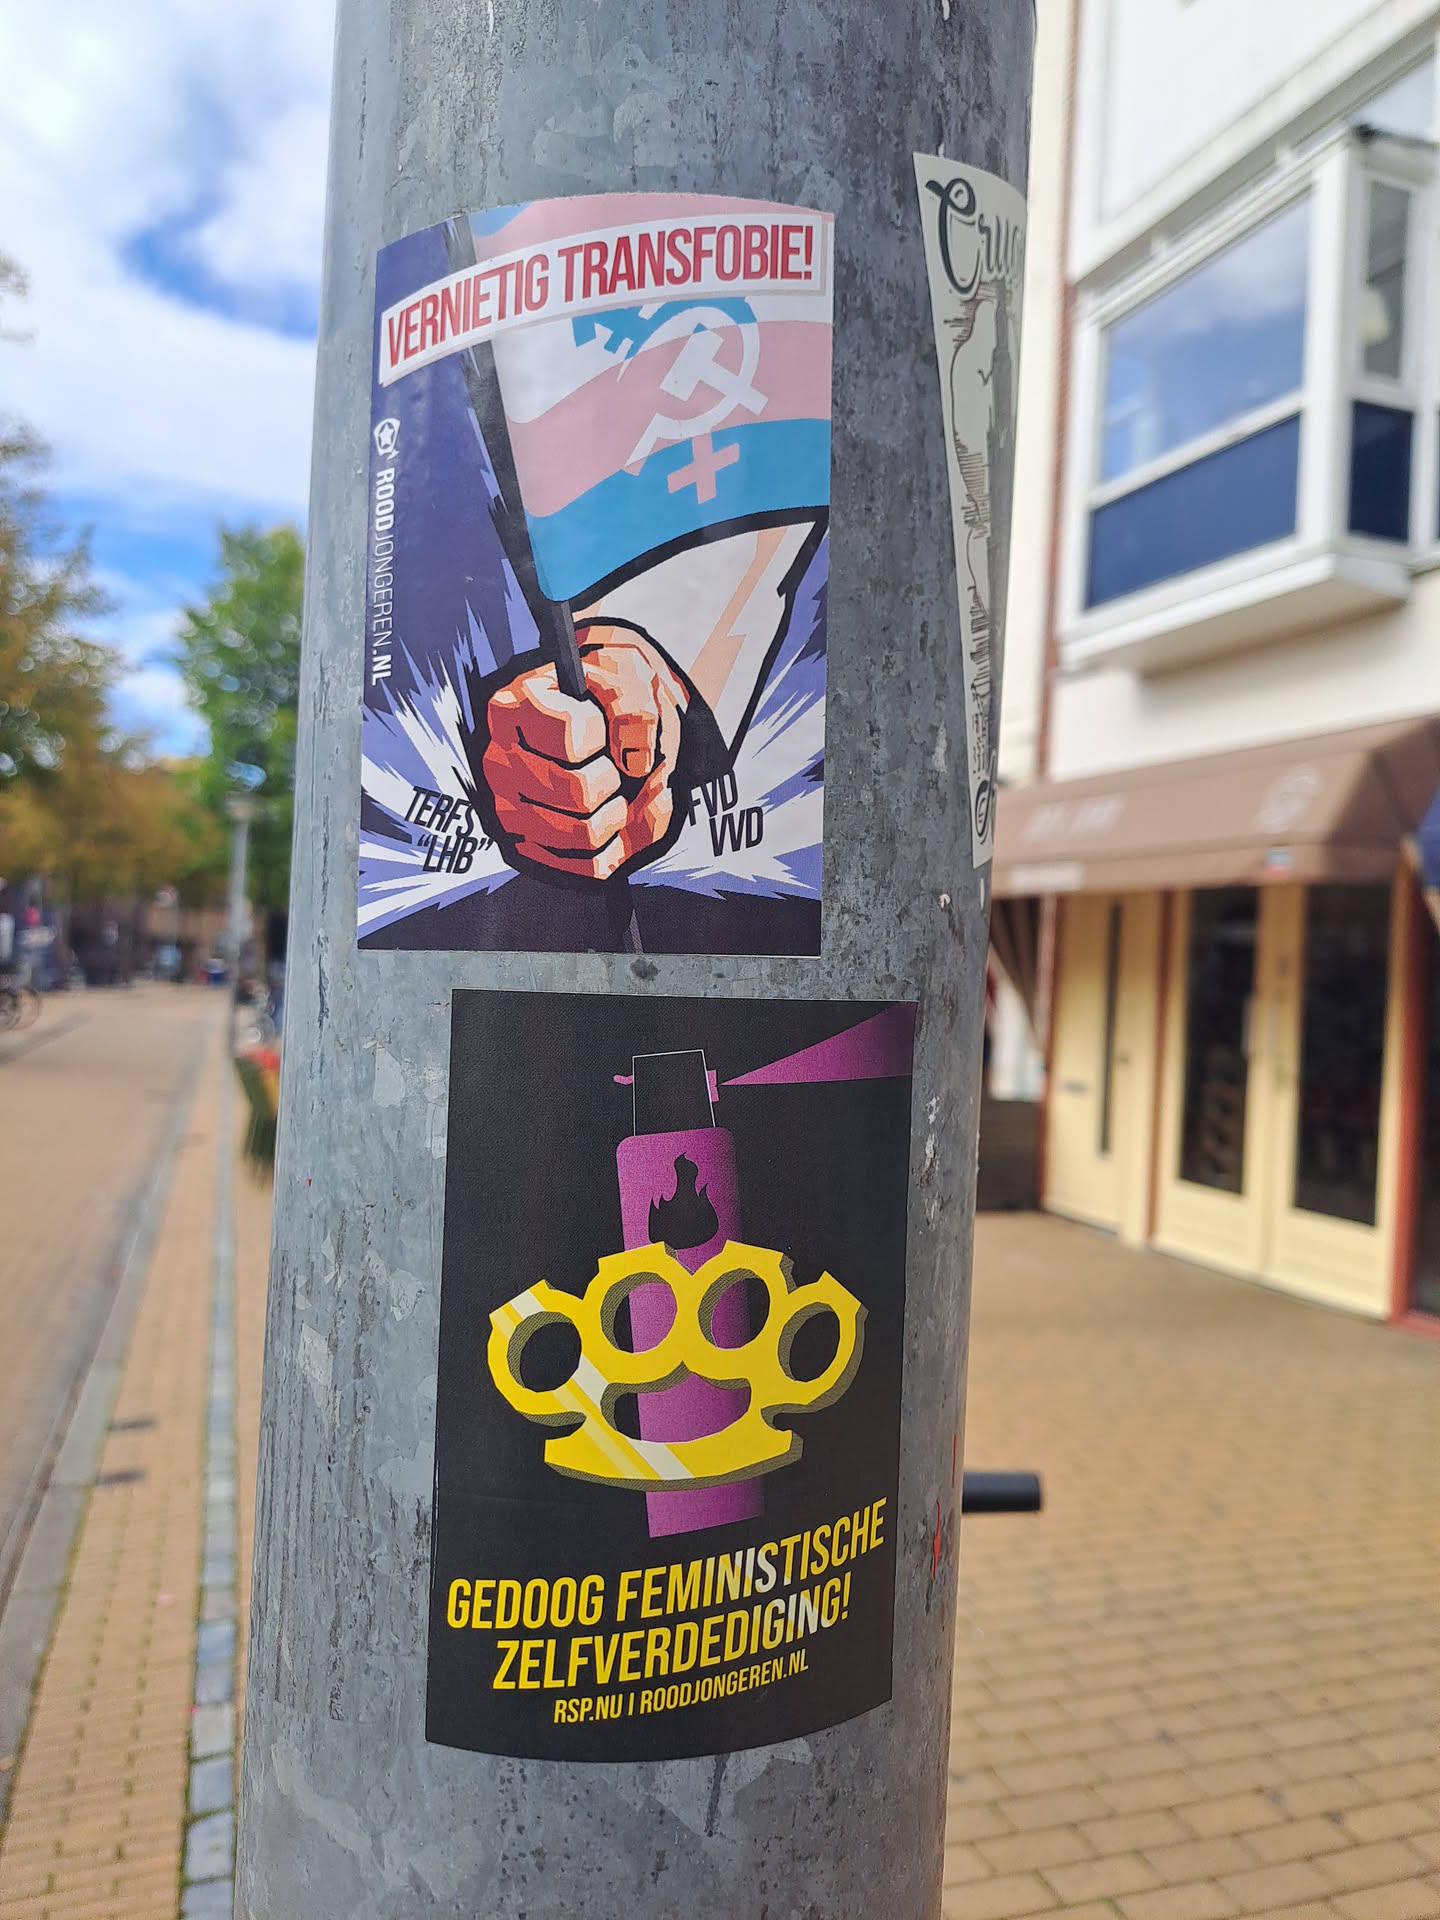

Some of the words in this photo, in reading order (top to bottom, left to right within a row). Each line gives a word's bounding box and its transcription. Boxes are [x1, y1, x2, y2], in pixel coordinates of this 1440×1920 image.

[388, 254, 549, 369] VERNIETIG
[558, 223, 814, 303] TRANSFOBIE!
[371, 467, 396, 687] ROODJONGEREN.NL
[404, 785, 474, 838] TERFS
[685, 768, 738, 827] FVD
[709, 805, 764, 858] VVD
[447, 1575, 605, 1629] GEDOOG
[616, 1497, 888, 1622] FEMINISTISCHE
[493, 1571, 852, 1690] ZELFVERDEDIGING!
[553, 1693, 623, 1724] RSP.NU
[639, 1648, 809, 1714] ROODJONGEREN.NL
